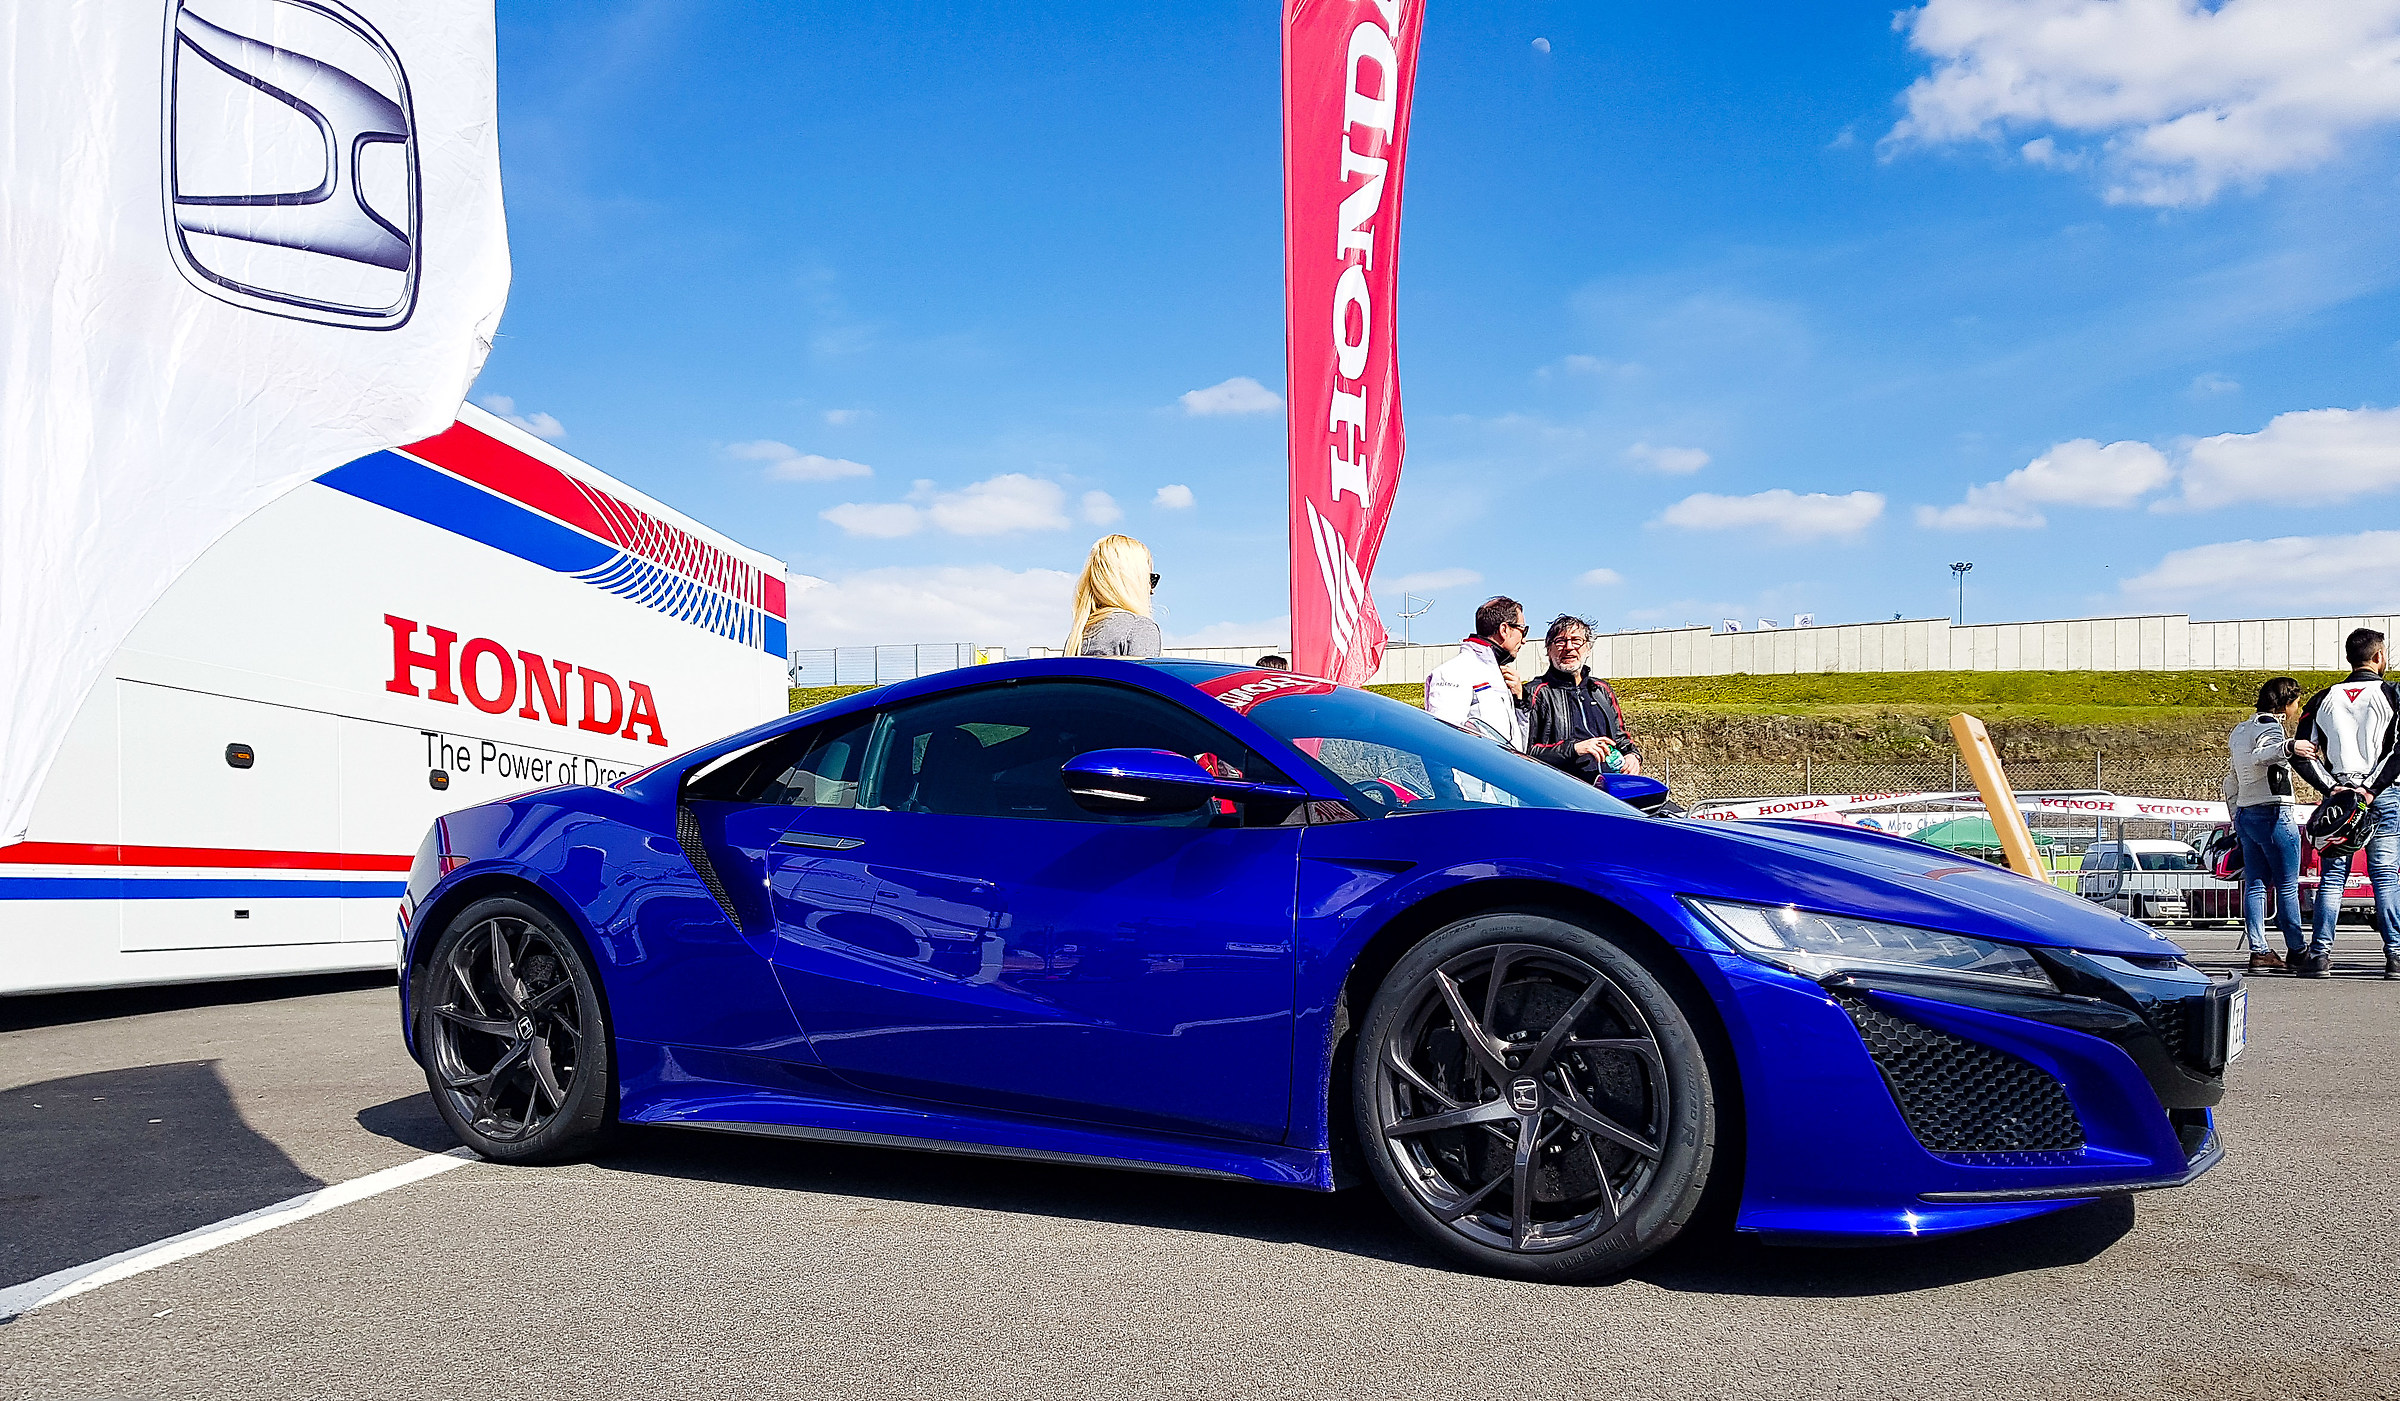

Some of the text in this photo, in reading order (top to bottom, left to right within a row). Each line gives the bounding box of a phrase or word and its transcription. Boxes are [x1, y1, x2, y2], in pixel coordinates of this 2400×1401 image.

[384, 613, 668, 747] HONDA
[420, 731, 471, 772] The
[481, 740, 552, 783] Power
[559, 757, 578, 784] of
[1758, 799, 1829, 815] HONDA
[2040, 797, 2115, 811] HONDA
[2137, 803, 2209, 816] HONDA
[1887, 819, 1912, 831] Moto
